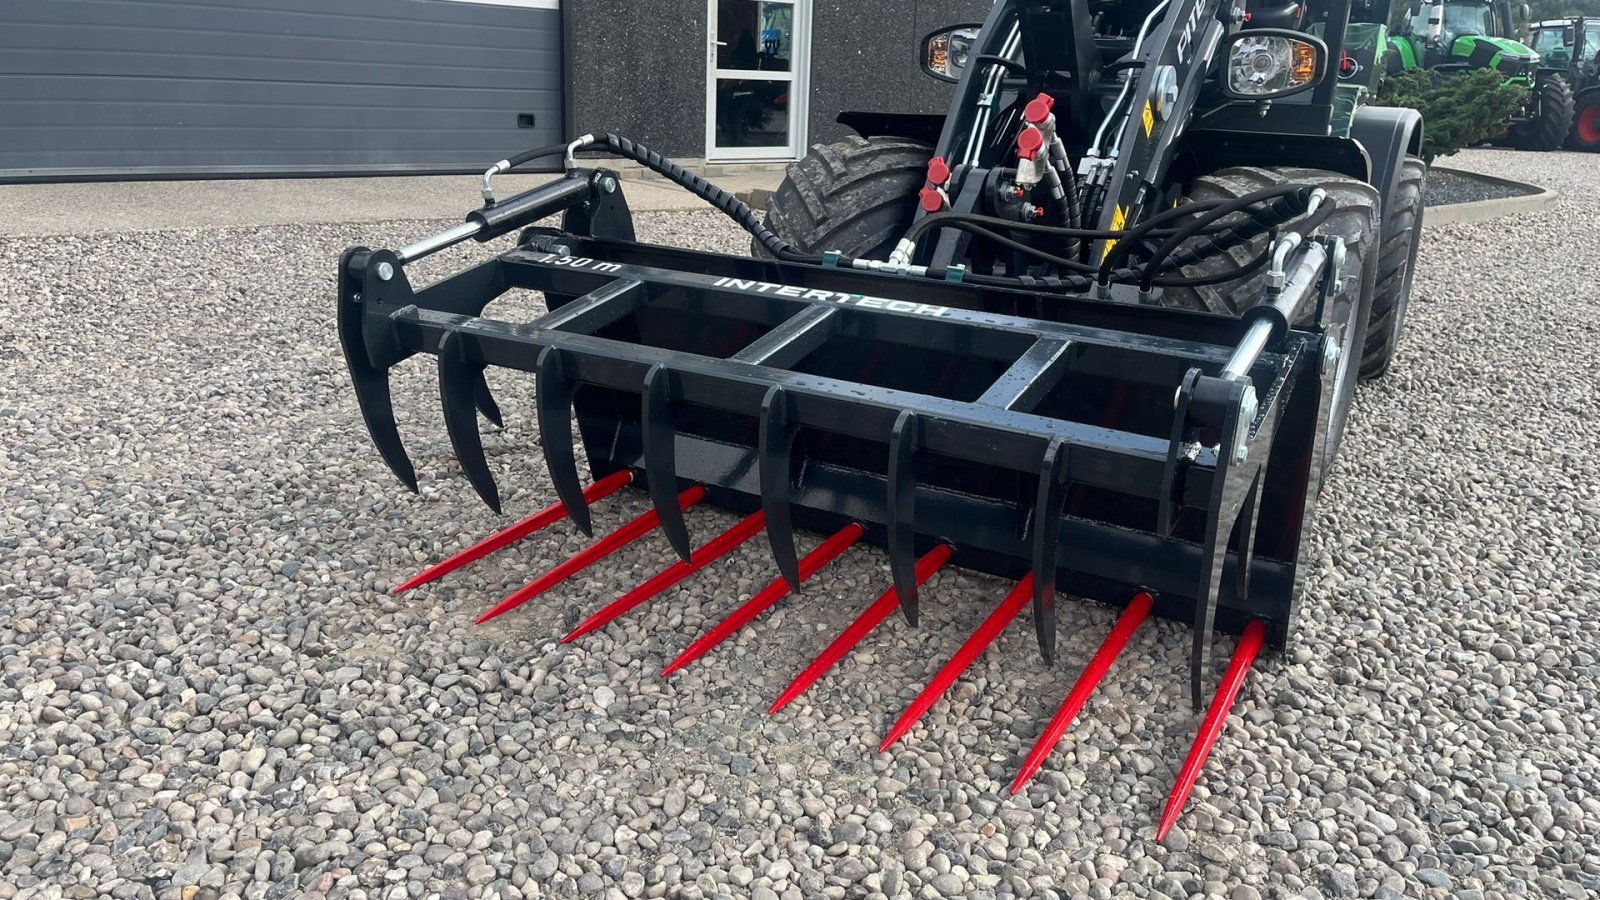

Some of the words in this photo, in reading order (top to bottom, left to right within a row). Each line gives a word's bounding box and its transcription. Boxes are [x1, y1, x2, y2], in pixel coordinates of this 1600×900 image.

[538, 253, 594, 268] 1.50
[591, 261, 622, 272] m
[713, 277, 949, 317] INTERTECH
